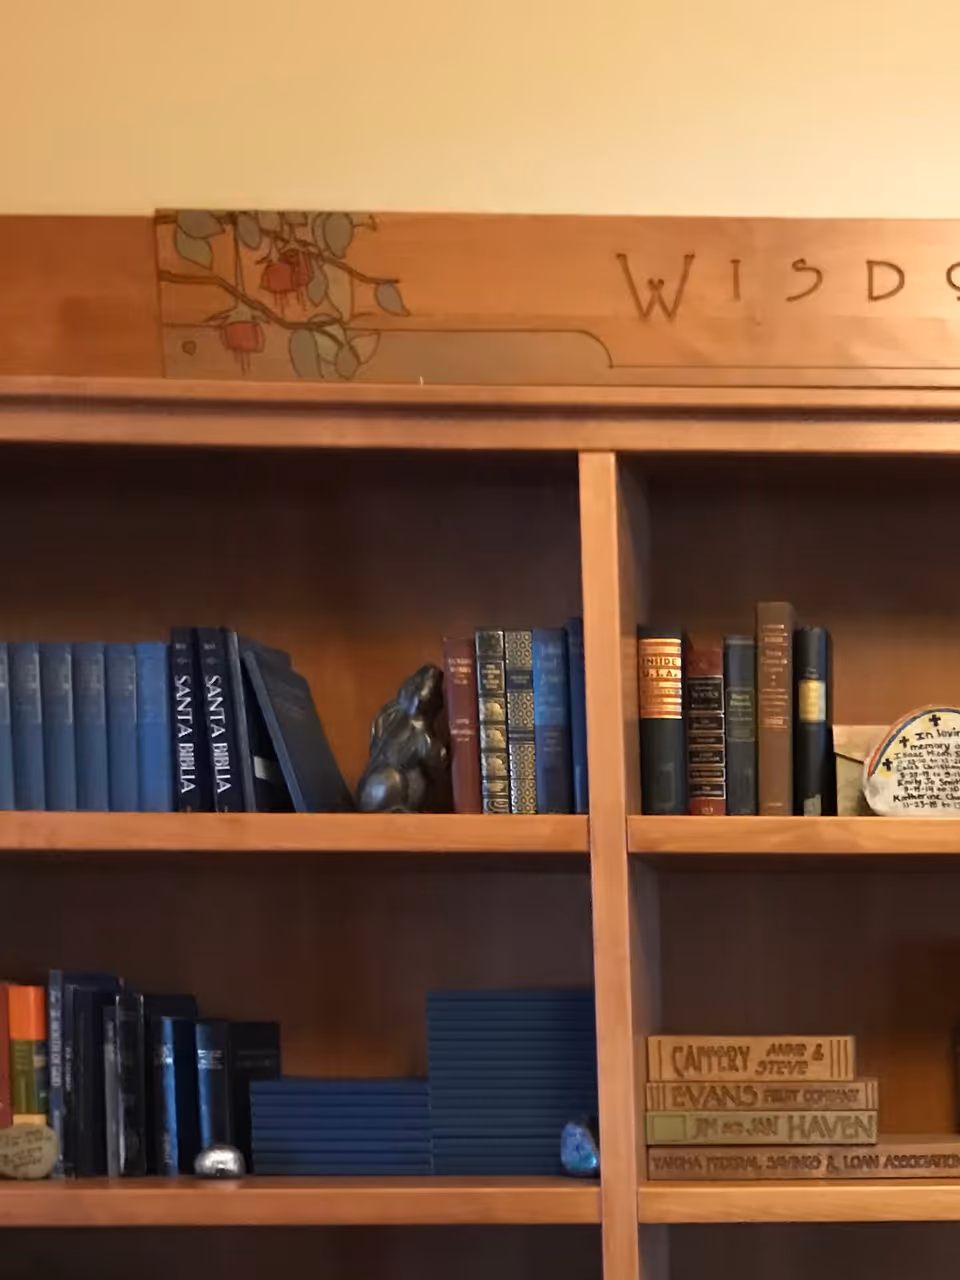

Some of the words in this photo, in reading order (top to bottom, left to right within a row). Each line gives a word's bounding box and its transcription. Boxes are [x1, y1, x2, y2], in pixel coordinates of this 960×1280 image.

[641, 656, 677, 667] INSIDE
[174, 674, 194, 738] SANTA
[204, 674, 227, 738] SANTA
[915, 732, 934, 741] In
[910, 743, 951, 754] memory
[177, 743, 197, 794] BIBLIA
[211, 743, 232, 794] BIBLIA
[897, 780, 922, 788] Emily
[755, 1060, 809, 1076] STEVE
[672, 1086, 759, 1107] EVANS
[788, 1114, 874, 1141] HAVEN
[842, 1155, 879, 1169] LOAN
